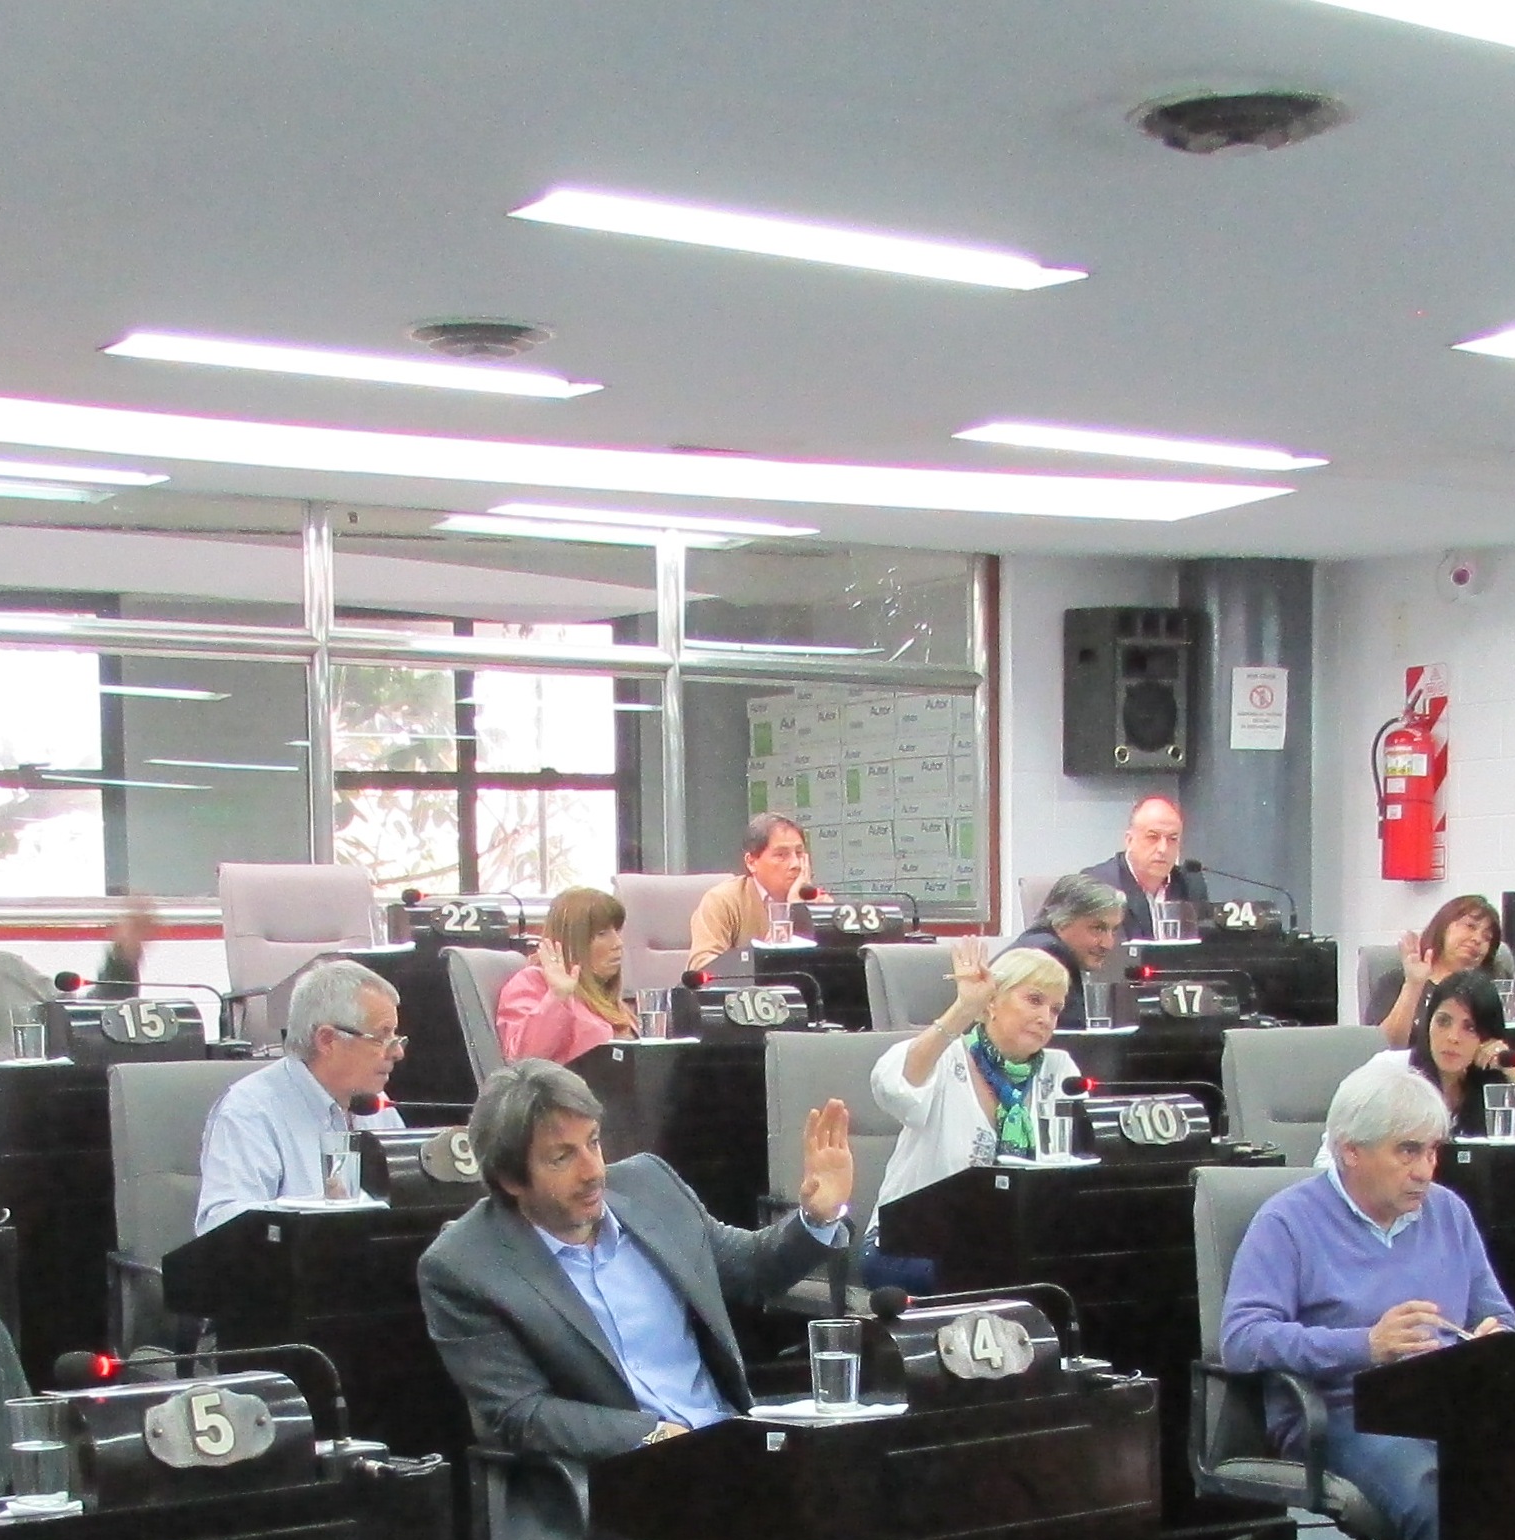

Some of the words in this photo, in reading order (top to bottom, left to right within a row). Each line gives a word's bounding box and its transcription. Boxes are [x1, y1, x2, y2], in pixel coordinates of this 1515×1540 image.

[870, 706, 890, 716] Autor
[926, 699, 948, 709] Autor
[817, 769, 836, 780] Autor
[868, 766, 889, 776] Autor
[921, 762, 943, 771] Autor
[818, 829, 838, 838] Autor
[868, 825, 888, 835] Autor
[920, 823, 942, 833] Autor
[442, 905, 481, 931] 22
[840, 905, 879, 930] 23
[1223, 902, 1257, 926] 24
[739, 991, 775, 1020] 16
[1174, 985, 1203, 1013] 17
[118, 1003, 165, 1038] 15
[1135, 1103, 1177, 1139] 10
[450, 1132, 479, 1175] 9
[974, 1319, 1003, 1369] 4
[191, 1392, 235, 1455] 5
